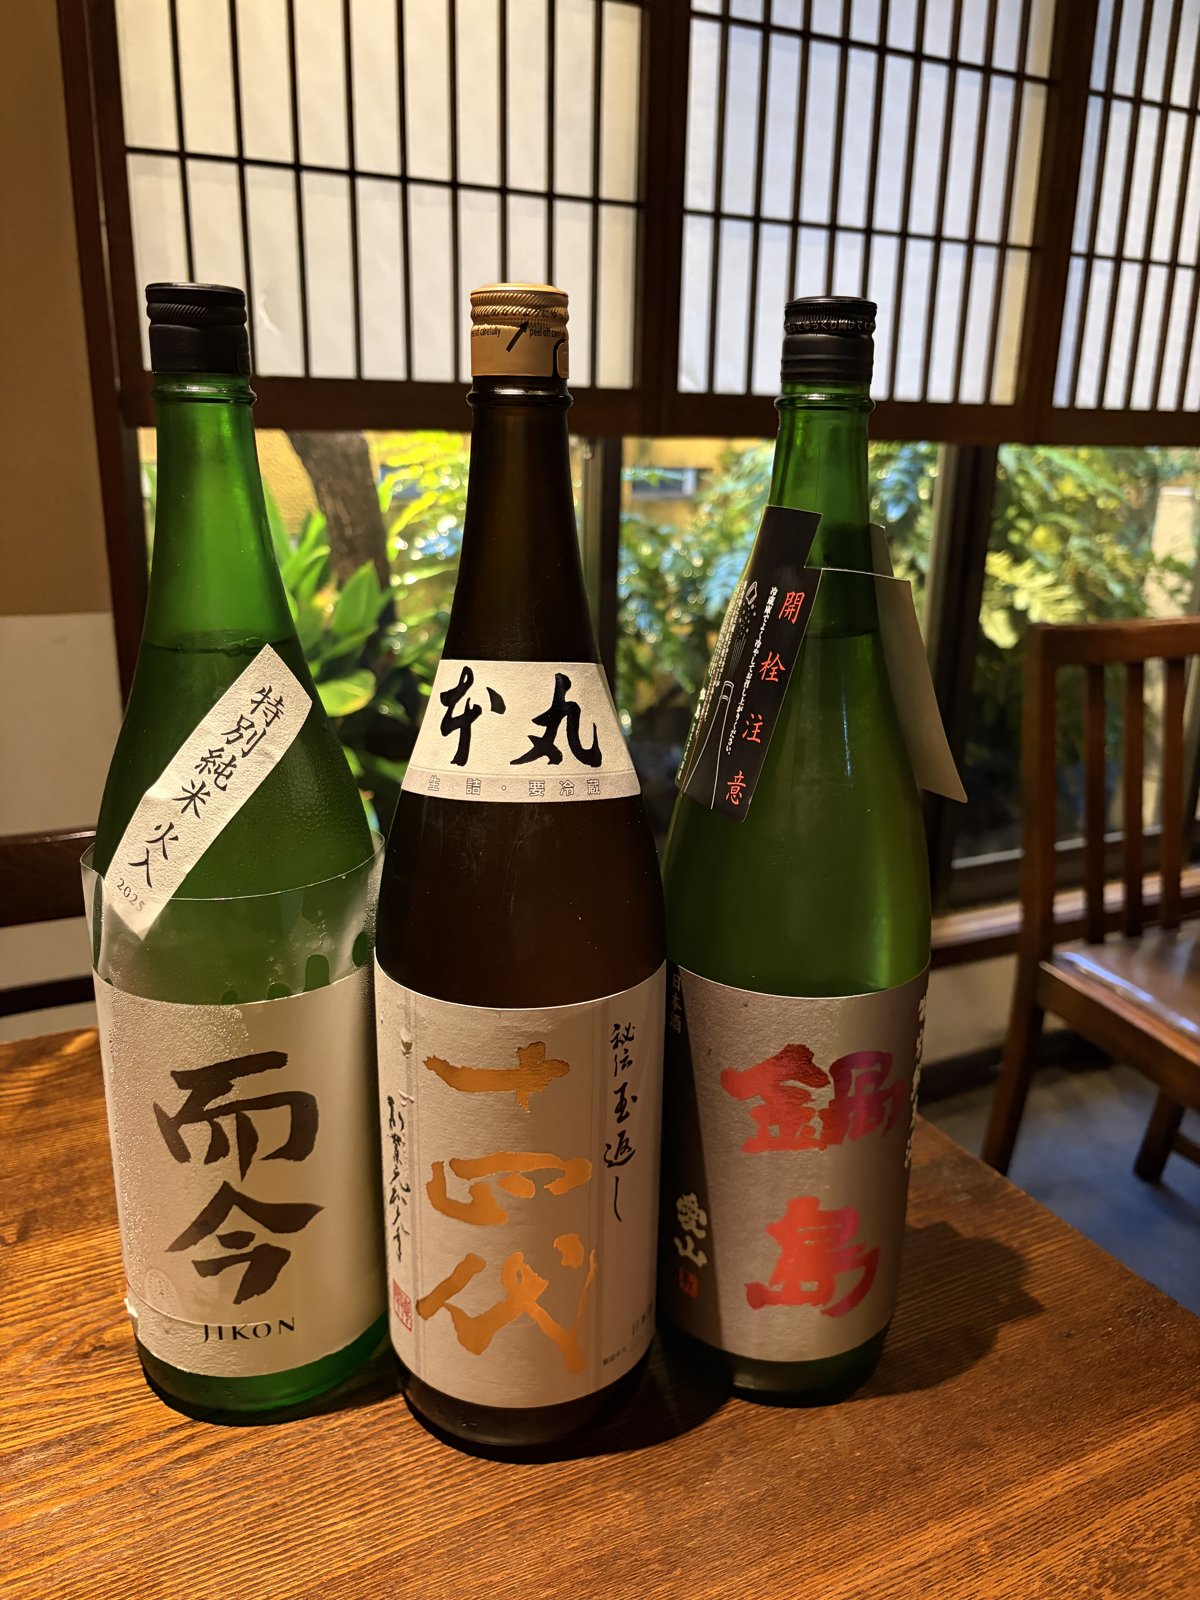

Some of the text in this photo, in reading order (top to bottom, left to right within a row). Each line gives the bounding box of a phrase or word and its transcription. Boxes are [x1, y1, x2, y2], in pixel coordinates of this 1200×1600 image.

[128, 684, 285, 889] 特別純米 火入
[427, 774, 602, 798] 生詰・要冷蔵
[440, 665, 603, 768] 本丸
[725, 591, 806, 806] 開栓注意
[116, 877, 146, 912] 2025
[152, 1050, 325, 1305] 而今
[415, 1040, 599, 1376] 十四代
[604, 1021, 639, 1222] 秘伝玉返し
[719, 1043, 908, 1318] 鍋島
[202, 1316, 296, 1344] JIKON
